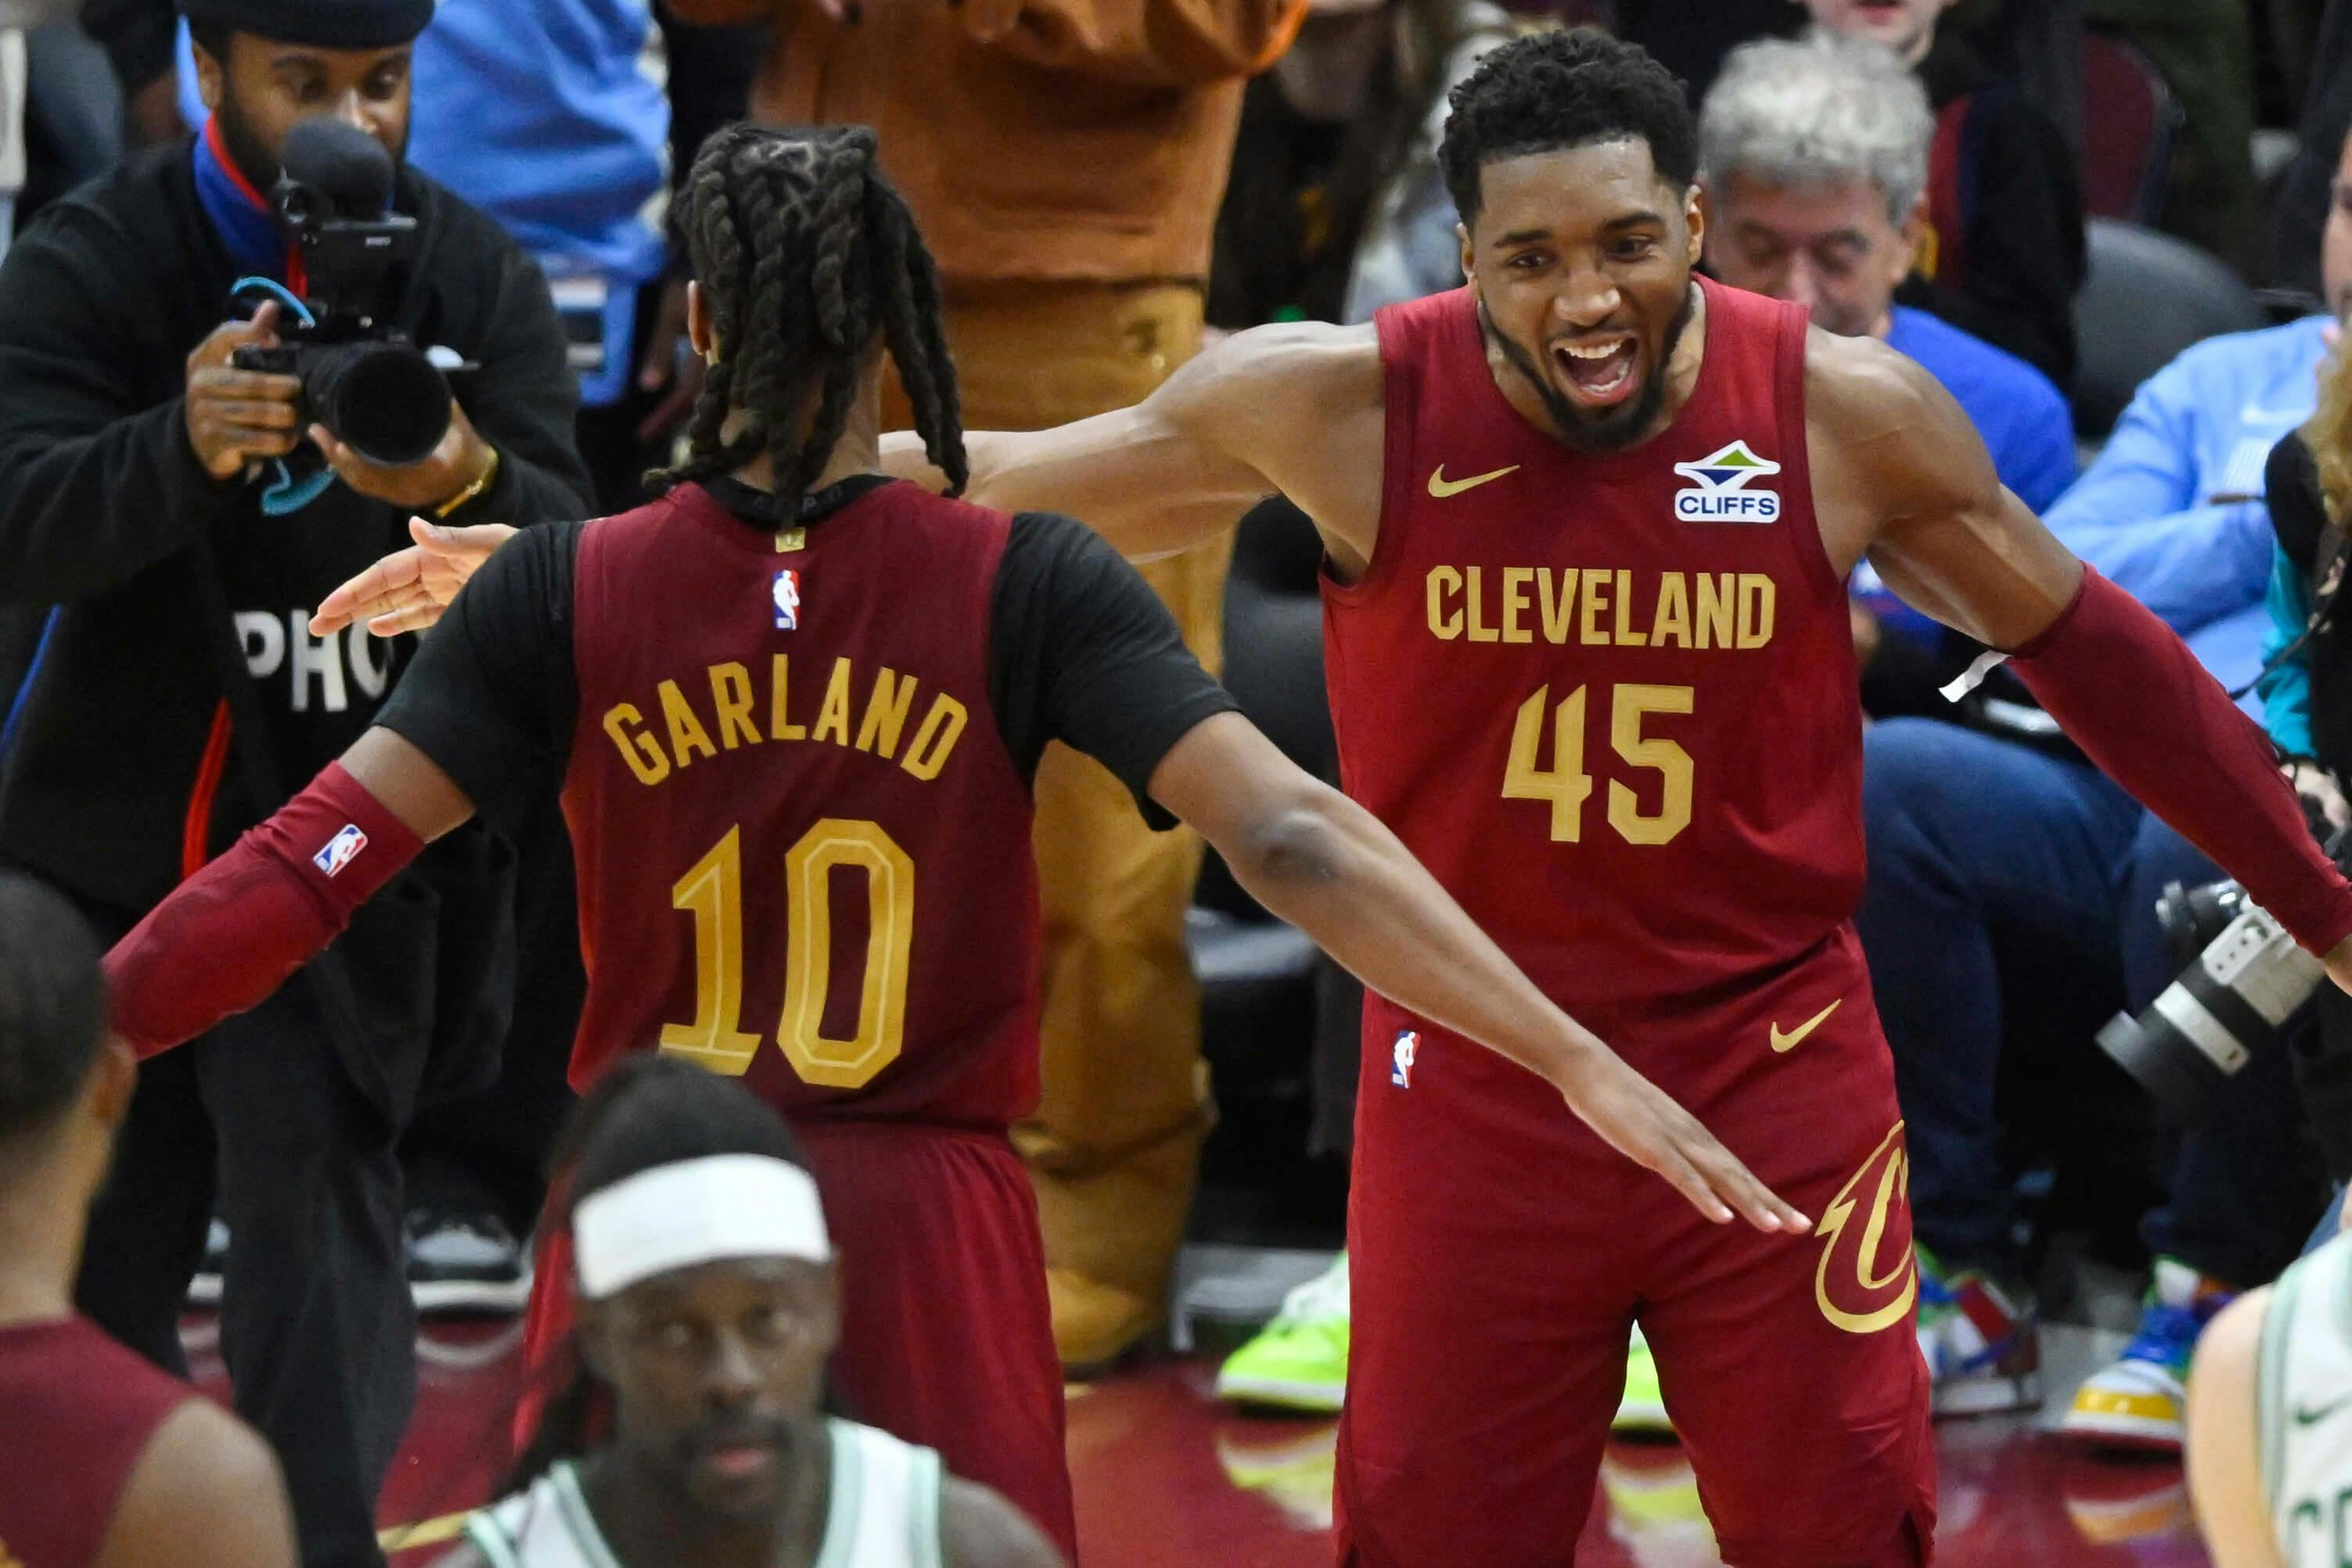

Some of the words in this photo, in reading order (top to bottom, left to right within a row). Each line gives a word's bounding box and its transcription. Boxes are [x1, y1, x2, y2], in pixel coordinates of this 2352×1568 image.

[1679, 495, 1775, 516] CLIFFS
[1426, 565, 1776, 649] CLEVELAND
[602, 653, 969, 786] GARLAND
[1501, 682, 1695, 845] 45
[658, 817, 915, 1089] 10
